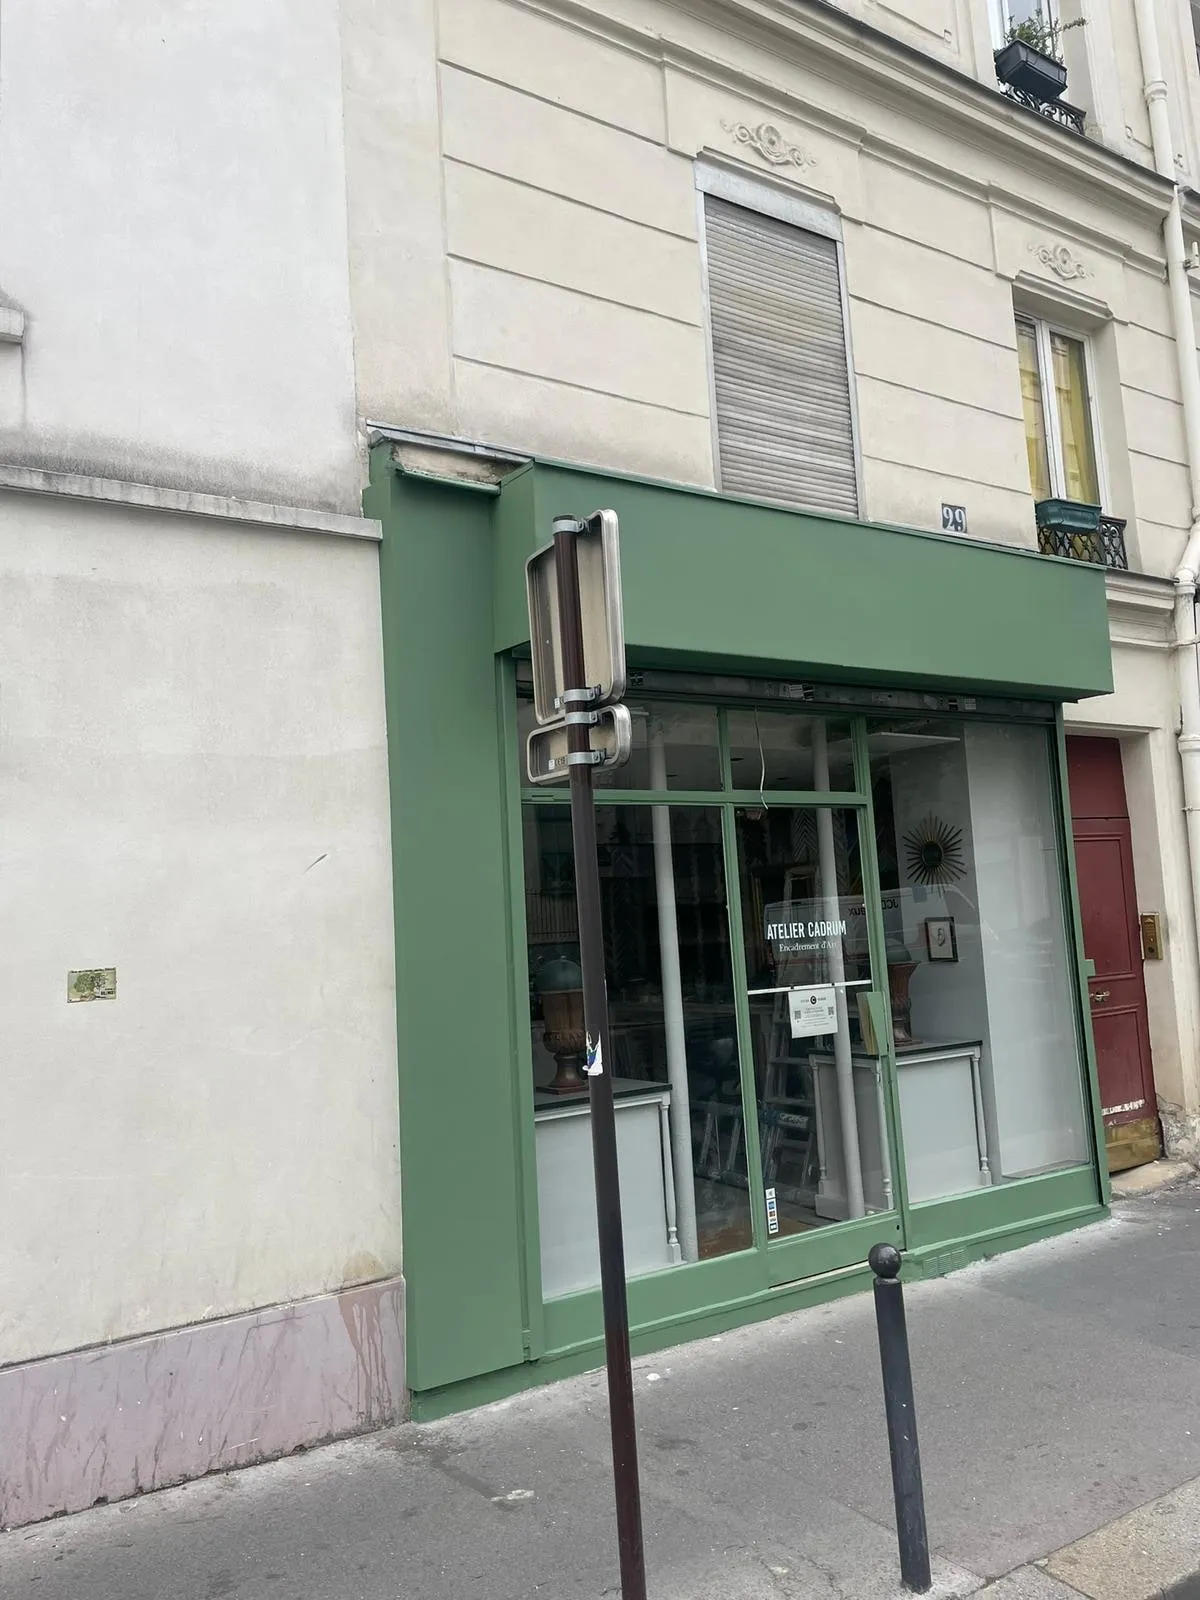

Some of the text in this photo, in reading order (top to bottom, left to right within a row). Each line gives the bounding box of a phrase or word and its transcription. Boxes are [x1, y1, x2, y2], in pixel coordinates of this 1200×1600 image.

[943, 507, 966, 532] 29
[767, 920, 847, 940] ATELIER CADRUM
[779, 942, 819, 952] Encadrement
